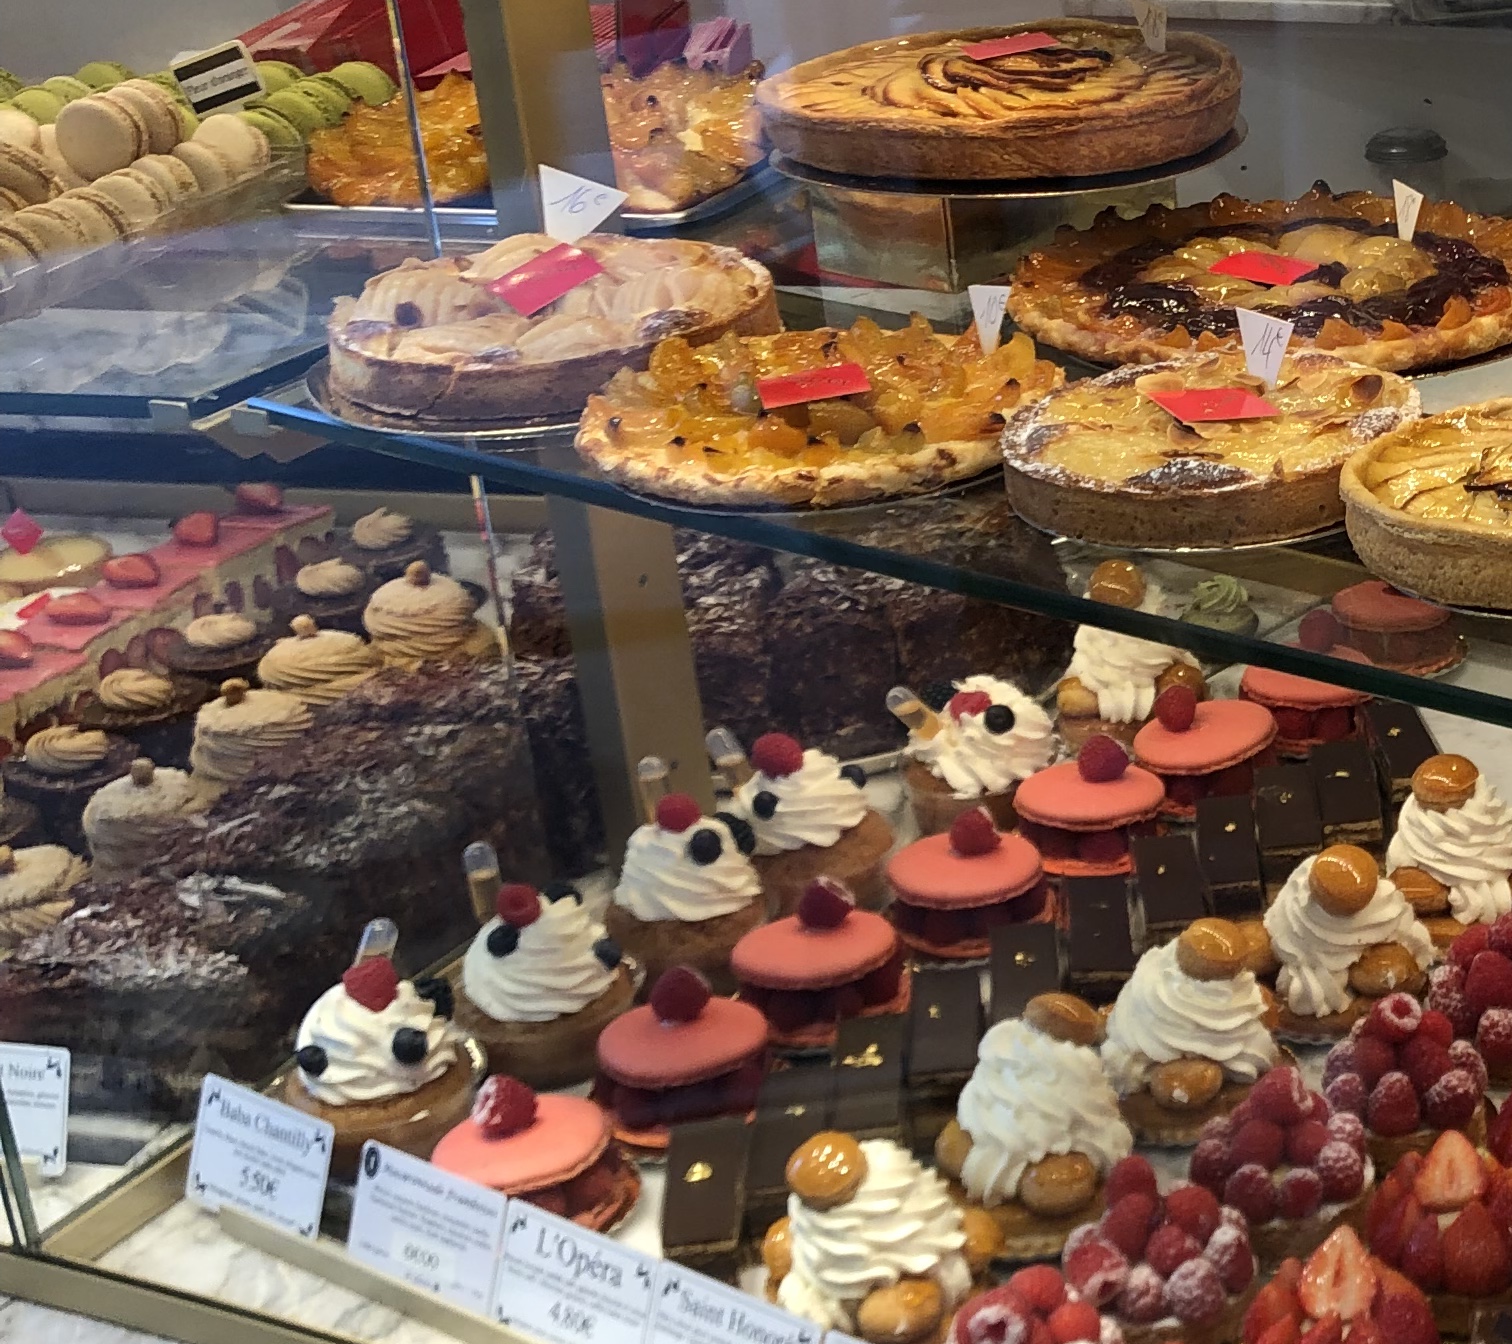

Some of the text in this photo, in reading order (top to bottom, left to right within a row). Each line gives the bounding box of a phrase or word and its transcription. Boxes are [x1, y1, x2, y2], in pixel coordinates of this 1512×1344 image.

[220, 1096, 251, 1127] Baba
[254, 1116, 313, 1157] Chantilly
[535, 1227, 623, 1288] L'Opéra
[678, 1287, 725, 1326] Saint
